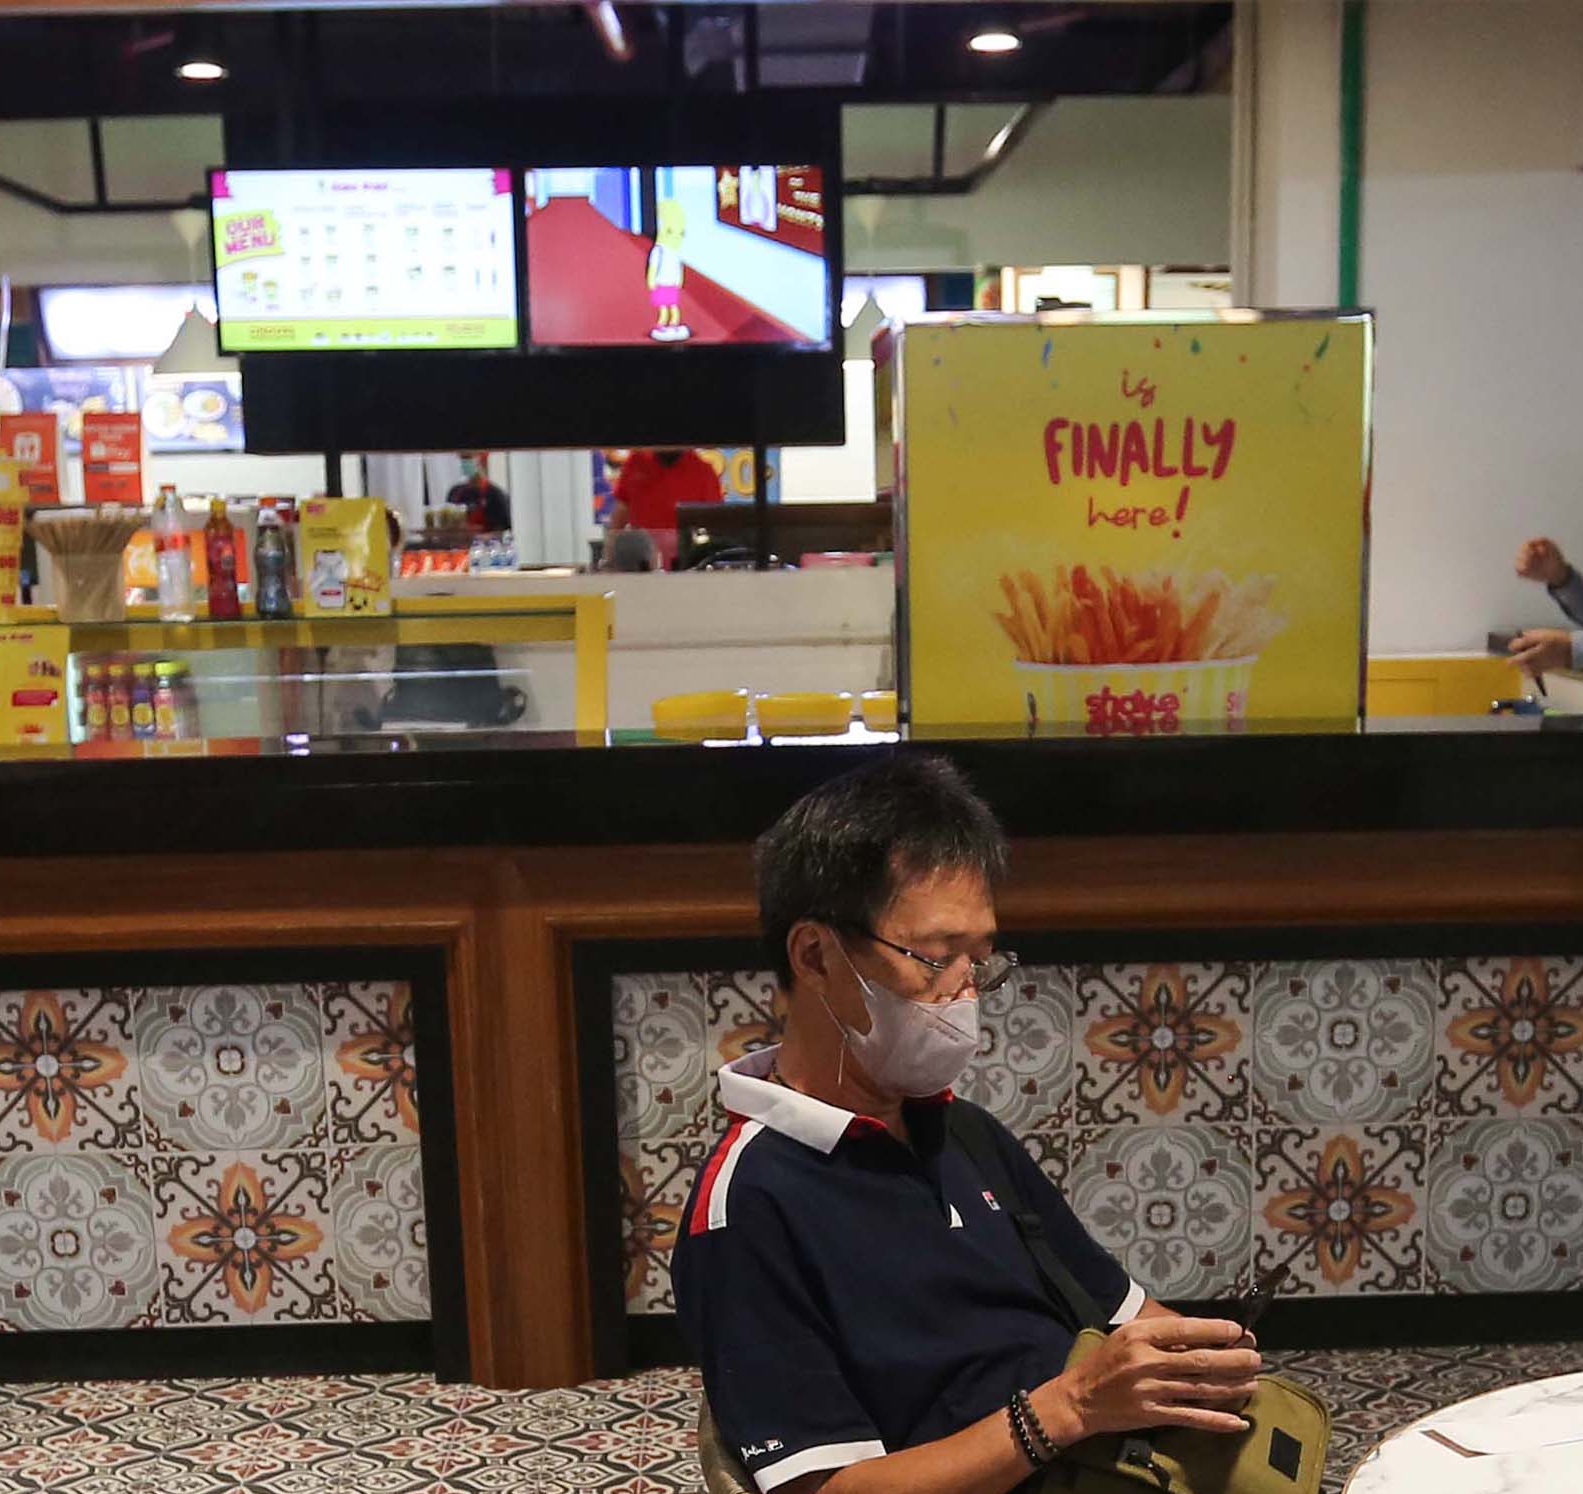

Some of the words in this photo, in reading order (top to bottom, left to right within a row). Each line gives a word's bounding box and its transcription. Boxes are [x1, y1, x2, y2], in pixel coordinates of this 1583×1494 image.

[1121, 368, 1157, 408] is
[1043, 415, 1237, 487] FINALLY
[1086, 485, 1190, 538] here!
